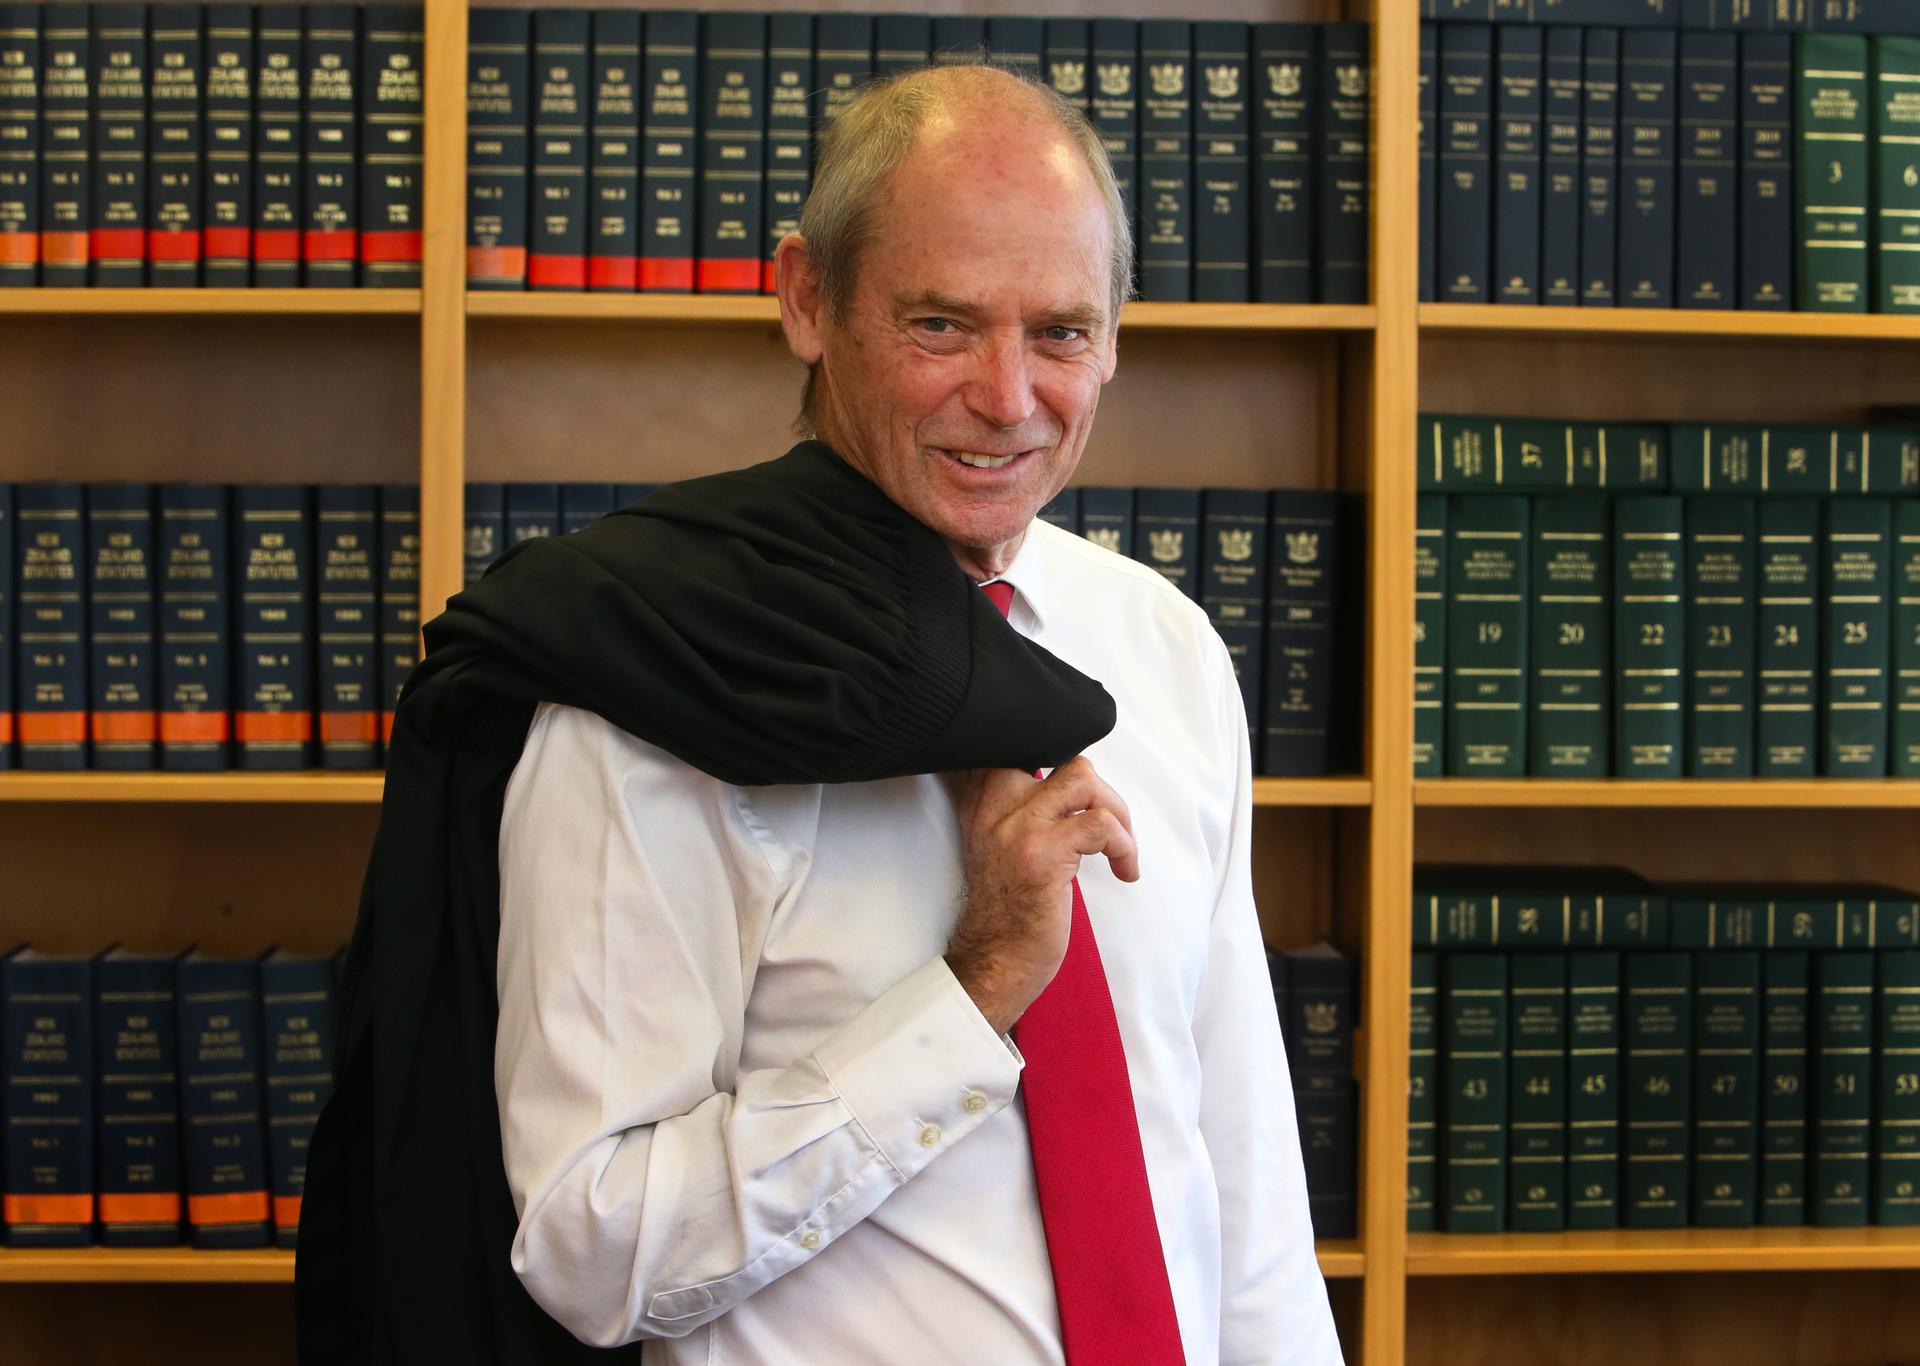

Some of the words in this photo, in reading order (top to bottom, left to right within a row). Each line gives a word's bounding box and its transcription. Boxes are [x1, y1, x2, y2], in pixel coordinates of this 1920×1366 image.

[1828, 161, 1843, 184] 3
[1903, 164, 1918, 187] 6
[1521, 442, 1543, 469] 37
[1786, 447, 1807, 475] 38
[1414, 621, 1426, 643] 8
[1479, 622, 1502, 644] 19
[1558, 622, 1585, 645] 20
[1640, 623, 1665, 646] 22
[1706, 624, 1732, 647] 23
[1774, 624, 1798, 646] 24
[1843, 622, 1868, 644] 25
[1793, 912, 1813, 939] 59
[1410, 1076, 1425, 1098] 2
[1462, 1078, 1488, 1100] 43
[1525, 1077, 1550, 1097] 44
[1581, 1074, 1607, 1096] 45
[1644, 1074, 1671, 1096] 46
[1711, 1074, 1738, 1095] 47
[1774, 1074, 1799, 1096] 50
[1834, 1074, 1855, 1095] 51
[1895, 1073, 1919, 1095] 53
